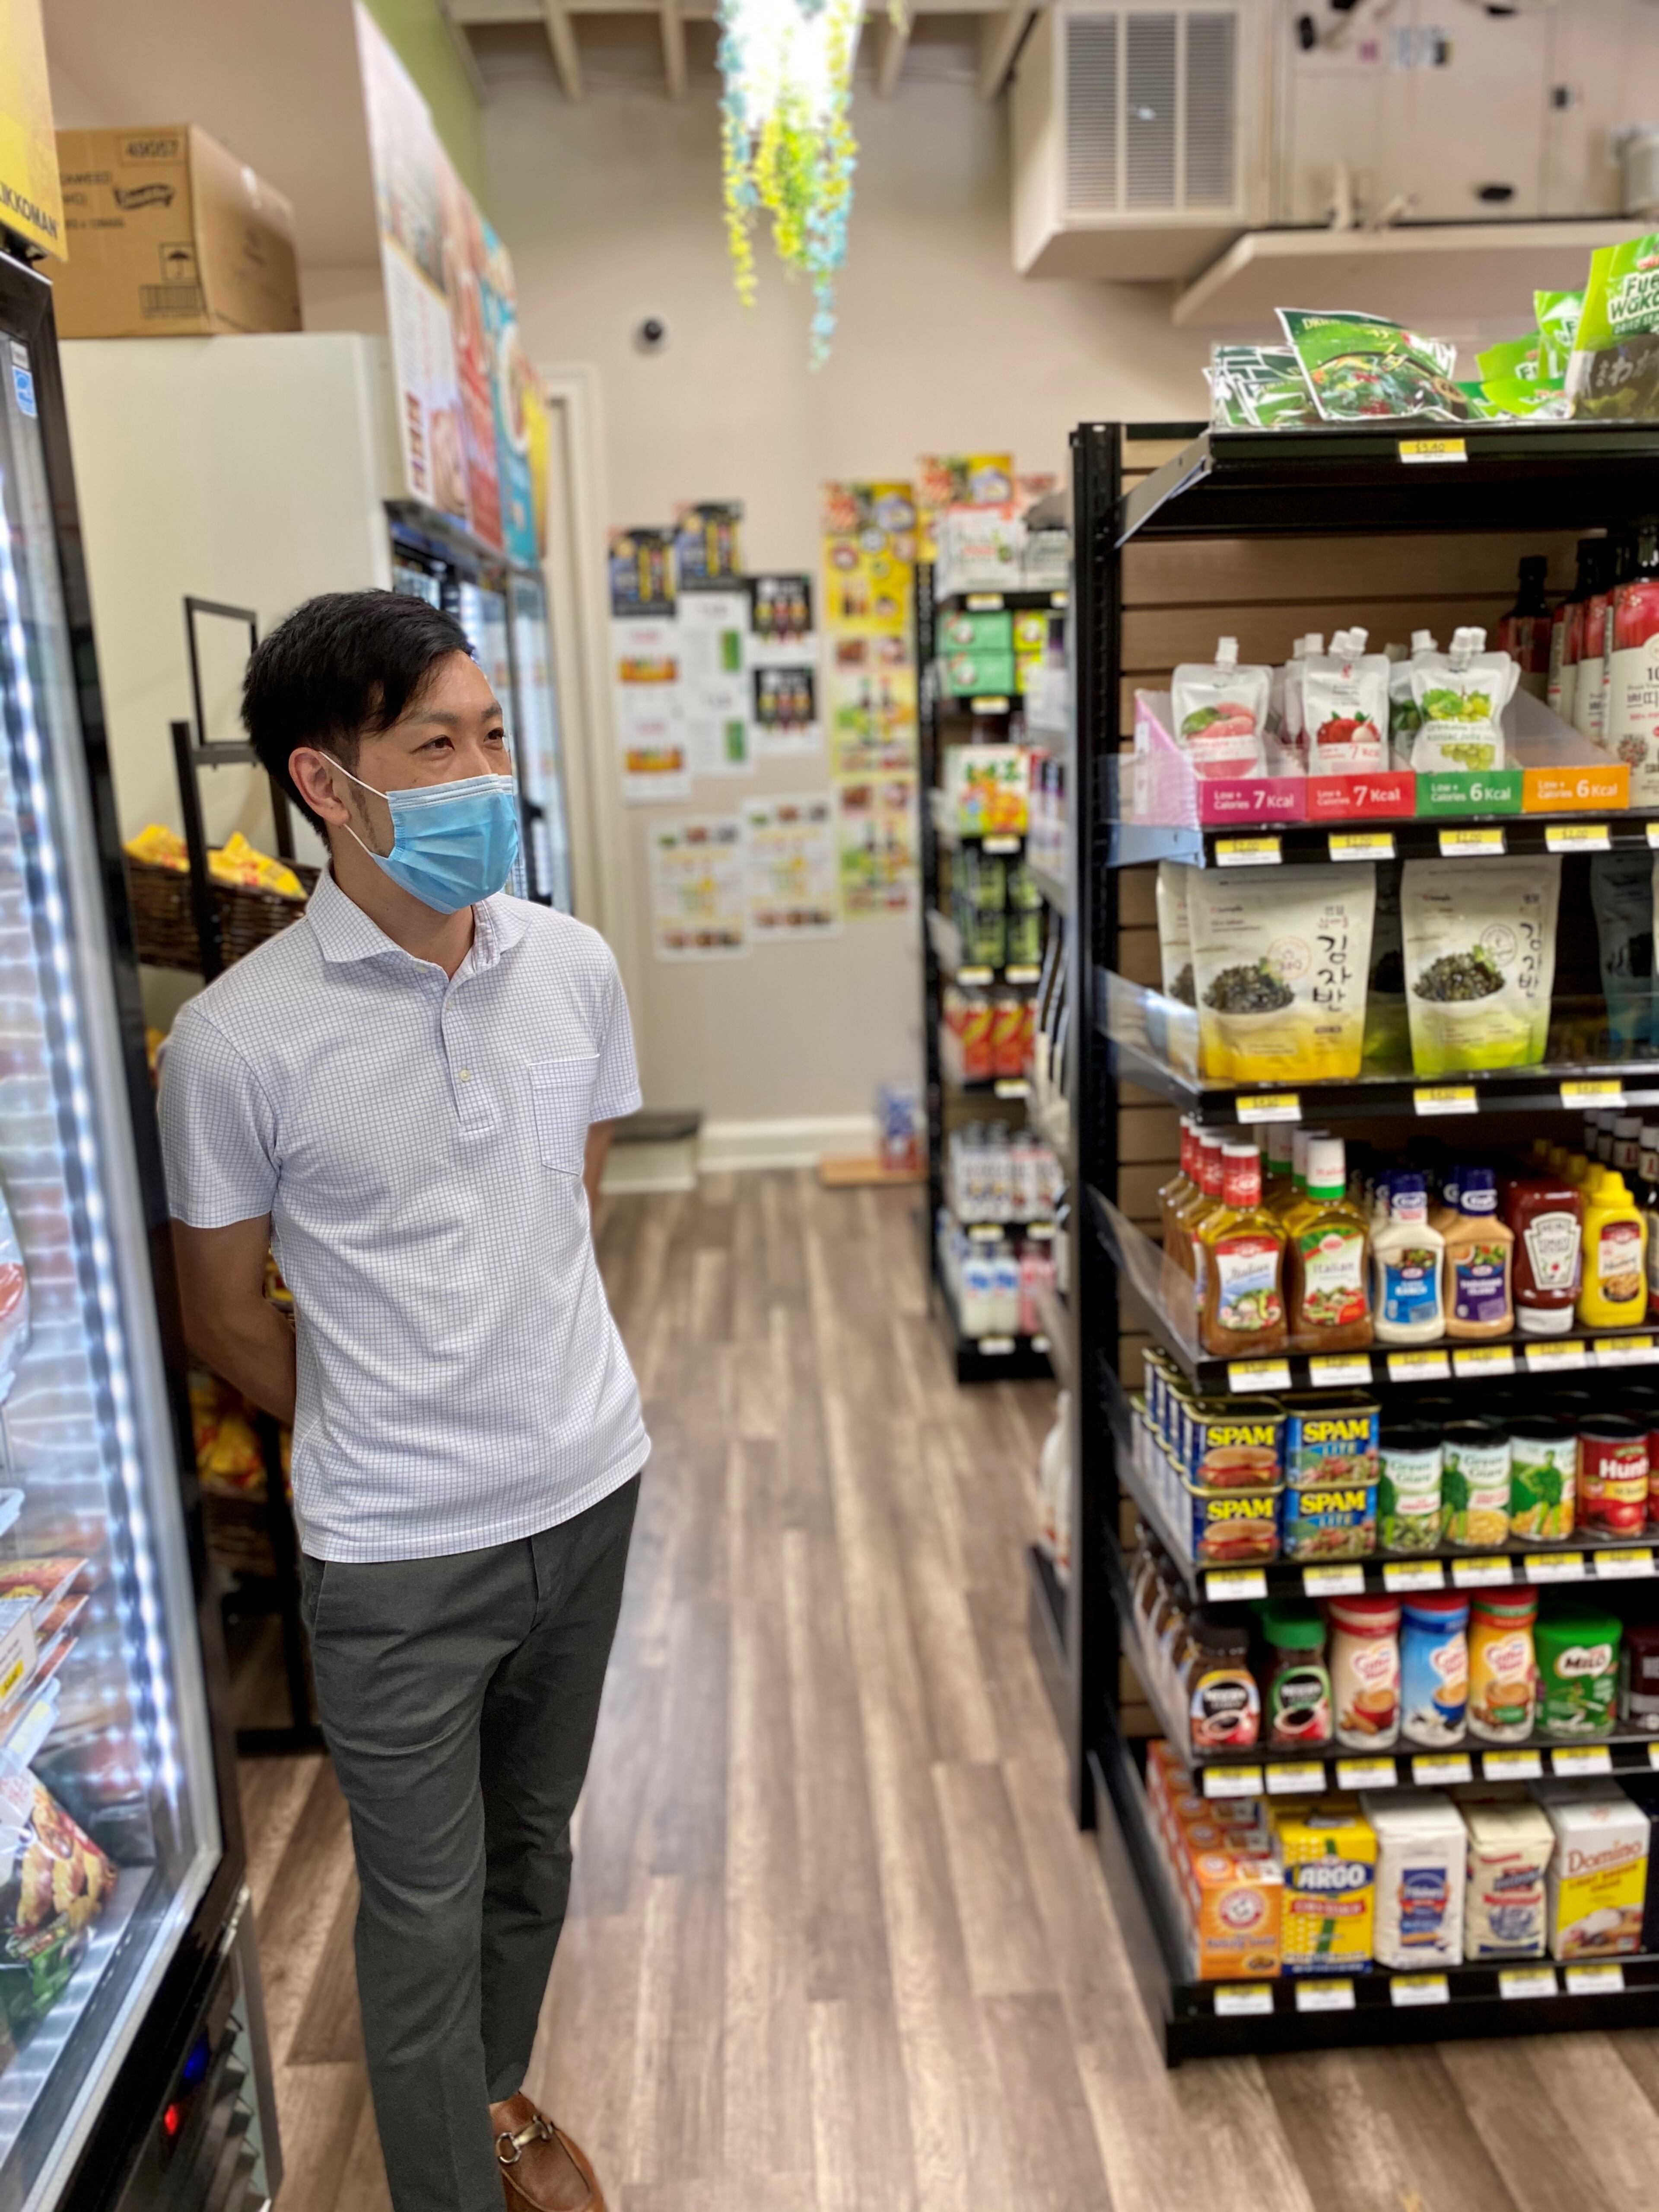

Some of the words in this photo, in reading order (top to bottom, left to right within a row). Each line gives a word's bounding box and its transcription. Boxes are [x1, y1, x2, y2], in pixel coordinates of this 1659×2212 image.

[1416, 442, 1445, 453] $3.40
[1431, 783, 1451, 792] Low
[1470, 782, 1483, 801] 6
[1484, 787, 1512, 800] Kcal
[1538, 781, 1558, 790] Low
[1576, 779, 1589, 798] 6
[1591, 783, 1618, 797] Kcal
[1214, 791, 1234, 799] Low
[1253, 790, 1266, 809] 7
[1267, 794, 1295, 809] Kcal
[1317, 797, 1350, 806] Calories
[1353, 785, 1368, 807] 7
[1370, 787, 1401, 802] Kcal
[1431, 792, 1466, 802] Calories
[1538, 789, 1573, 800] Calories
[1214, 800, 1250, 810] Calories
[1519, 922, 1543, 998] 김자반
[1313, 934, 1353, 1012] 김자반
[1313, 1262, 1355, 1273] Italian
[1207, 1425, 1275, 1447] SPAM
[1303, 1418, 1370, 1443] SPAM
[1322, 1443, 1357, 1456] LITE
[1463, 1454, 1504, 1466] Green
[1469, 1468, 1503, 1478] Giant
[1300, 1490, 1367, 1514] SPAM
[1207, 1497, 1274, 1522] SPAM
[1319, 1514, 1353, 1528] LITE
[1567, 1839, 1642, 1873] Domino
[1297, 1863, 1367, 1890] ARGO
